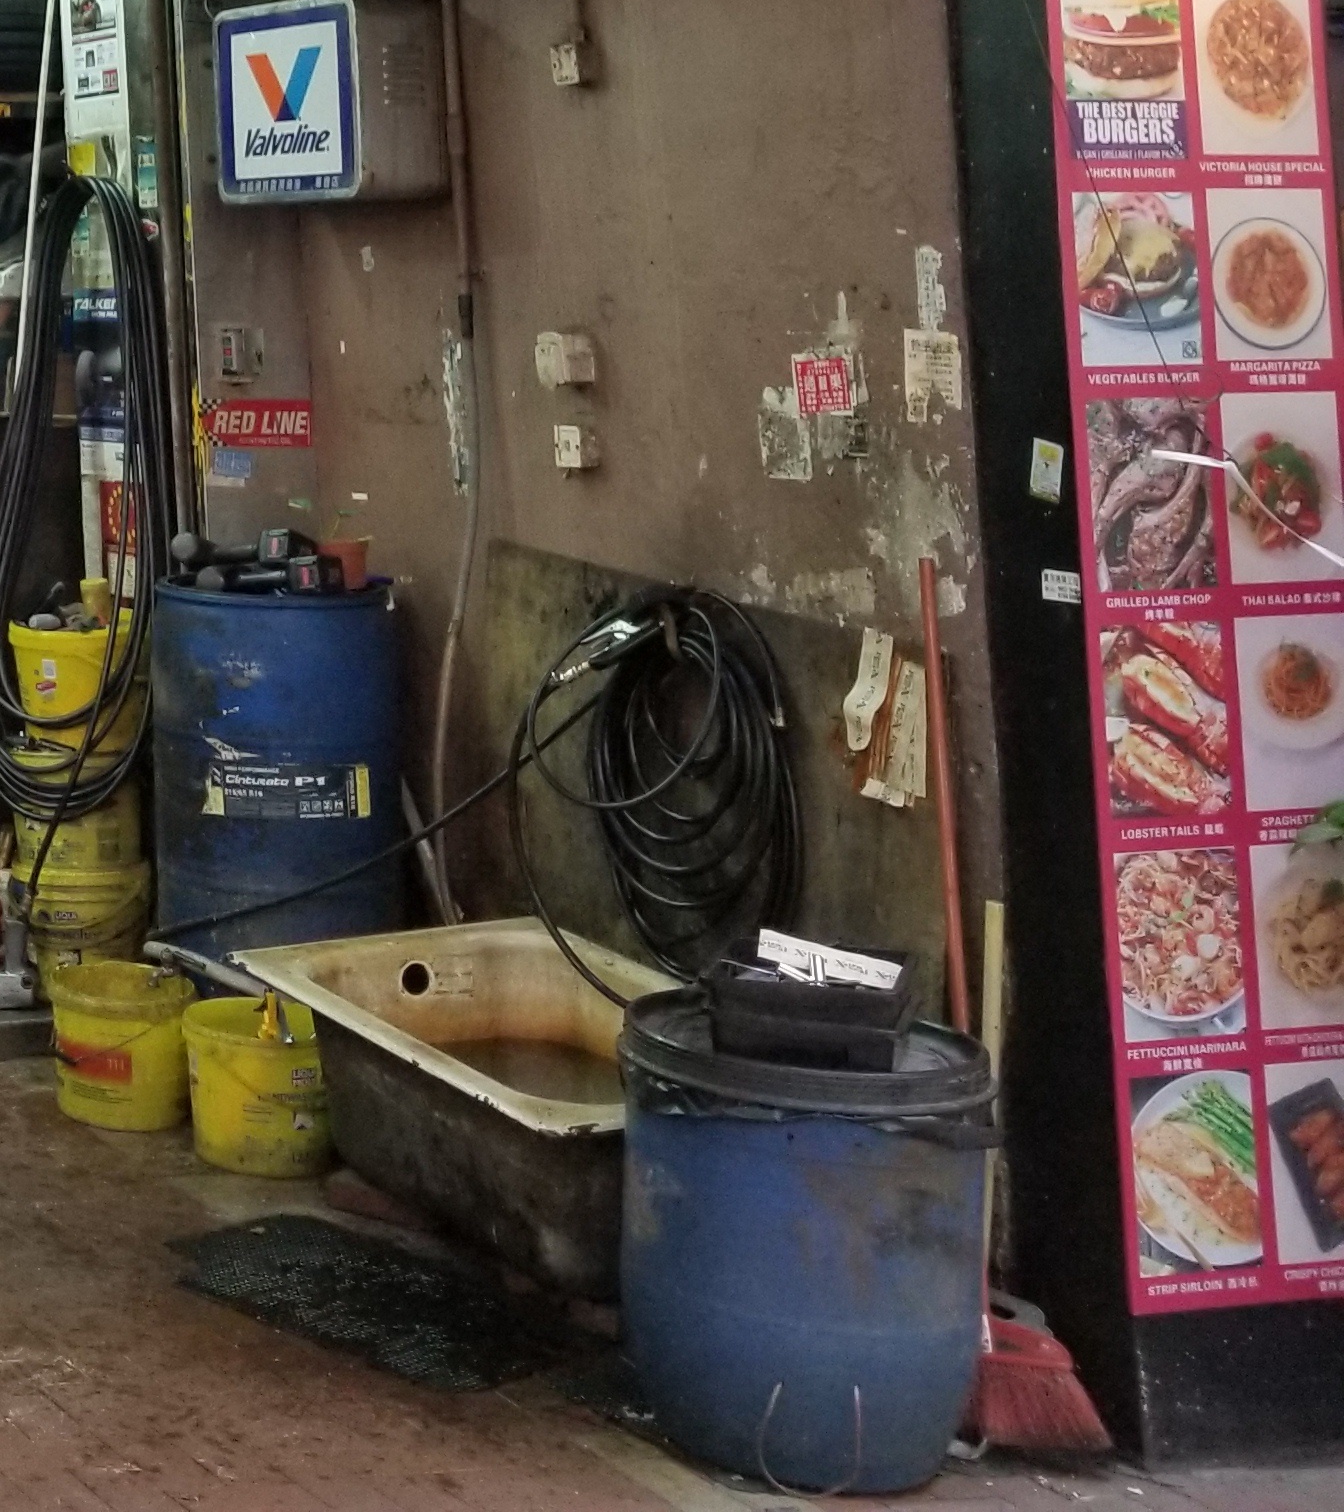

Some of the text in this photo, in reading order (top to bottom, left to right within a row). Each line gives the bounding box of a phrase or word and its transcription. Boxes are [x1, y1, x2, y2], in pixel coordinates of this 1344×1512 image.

[1076, 102, 1180, 120] THE BEST VEGGIE
[1083, 118, 1176, 144] BURGERS
[244, 125, 331, 159] Valvoline
[1086, 167, 1176, 178] CHICKEN BURGER
[1198, 161, 1326, 173] VICTORIA HOUSE SPECIAL
[1230, 360, 1321, 372] MARGARITA PIZZA
[1087, 371, 1201, 385] VEGETABLES BURGER
[212, 410, 309, 436] RED LINE
[1106, 593, 1212, 609] GRILLED LAMB CHOP
[1241, 595, 1266, 606] THAI
[1267, 593, 1302, 605] SALAD
[224, 774, 327, 787] Cinturato P1
[1262, 813, 1315, 829] SPAGHETT
[1120, 827, 1169, 840] LOBSTER
[1169, 824, 1200, 838] TAILS
[1127, 1040, 1247, 1060] FETTUCCINI MARINARA
[1147, 1281, 1178, 1297] STRIP
[1180, 1278, 1224, 1294] SIRLOIN
